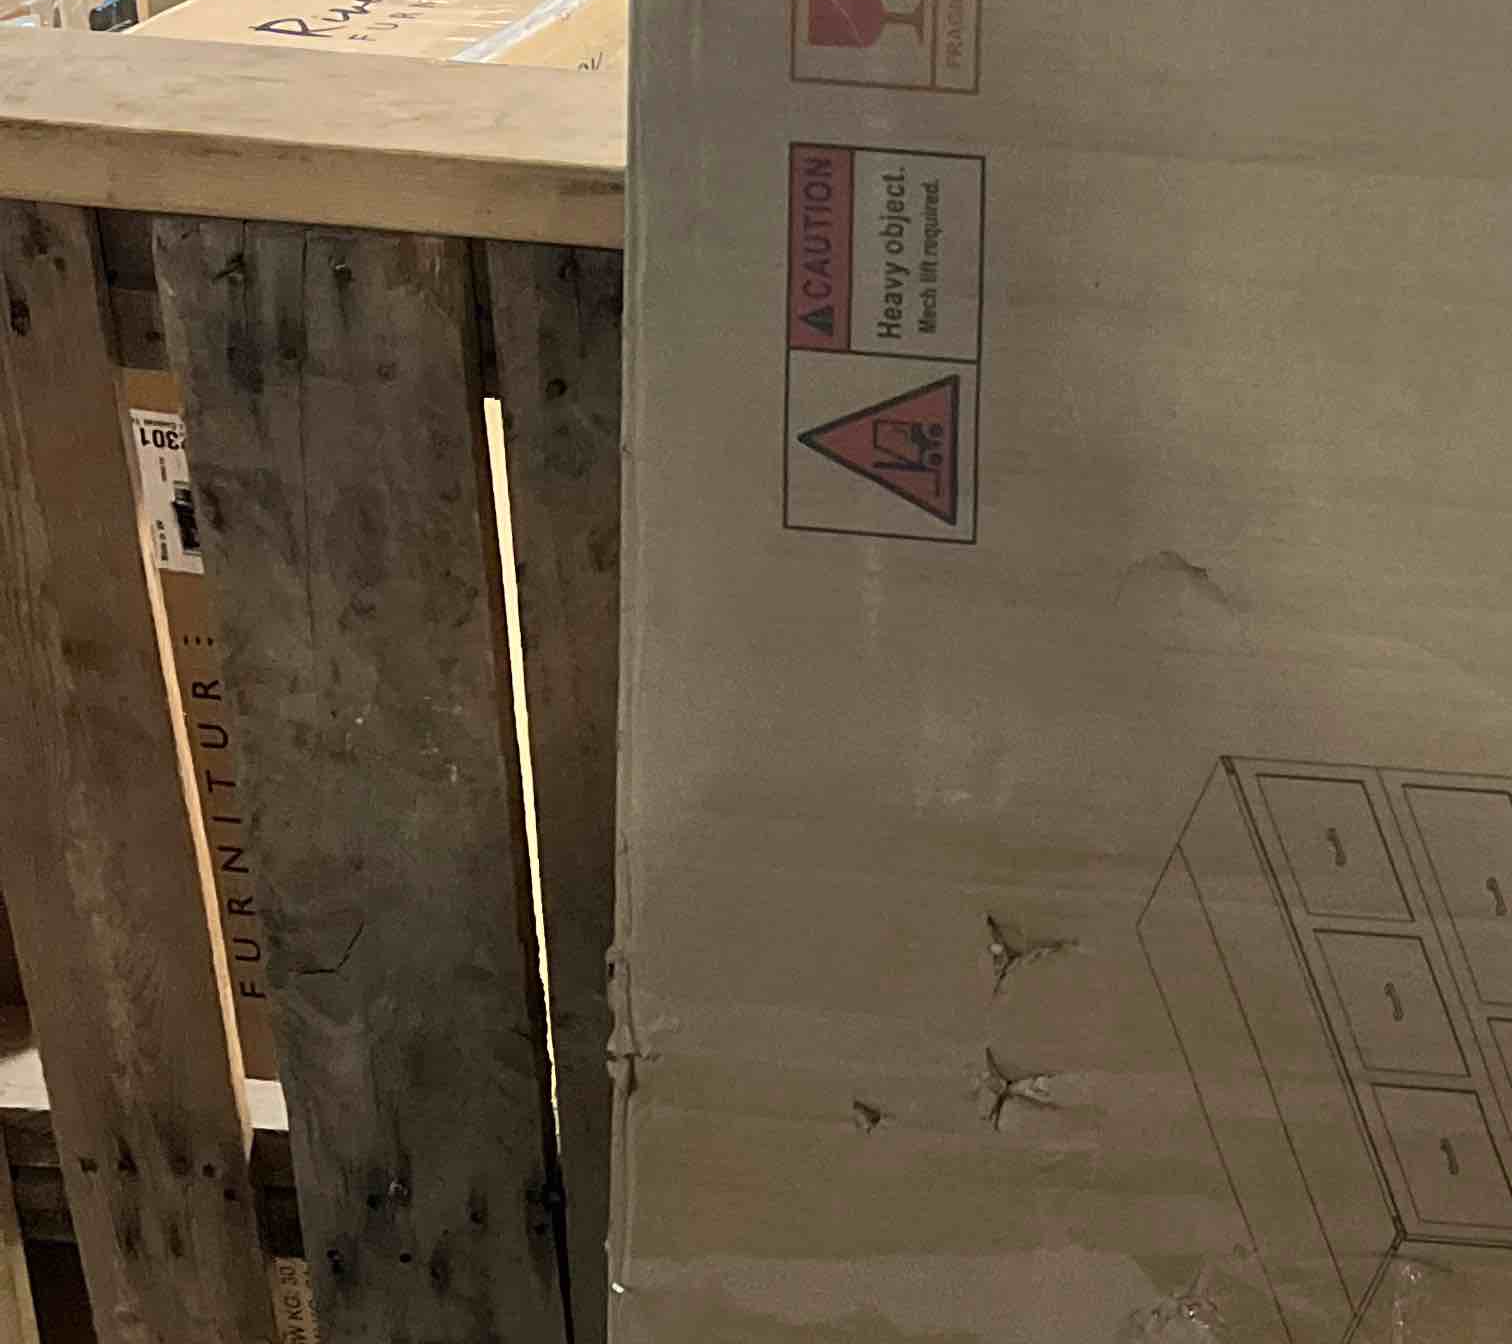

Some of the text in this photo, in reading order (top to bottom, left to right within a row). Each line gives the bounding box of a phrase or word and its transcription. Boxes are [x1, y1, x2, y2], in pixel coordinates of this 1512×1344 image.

[802, 156, 834, 298] CAUTION
[877, 167, 912, 339] Heavy object.
[918, 178, 943, 335] Mech lift required.
[139, 428, 184, 450] 301
